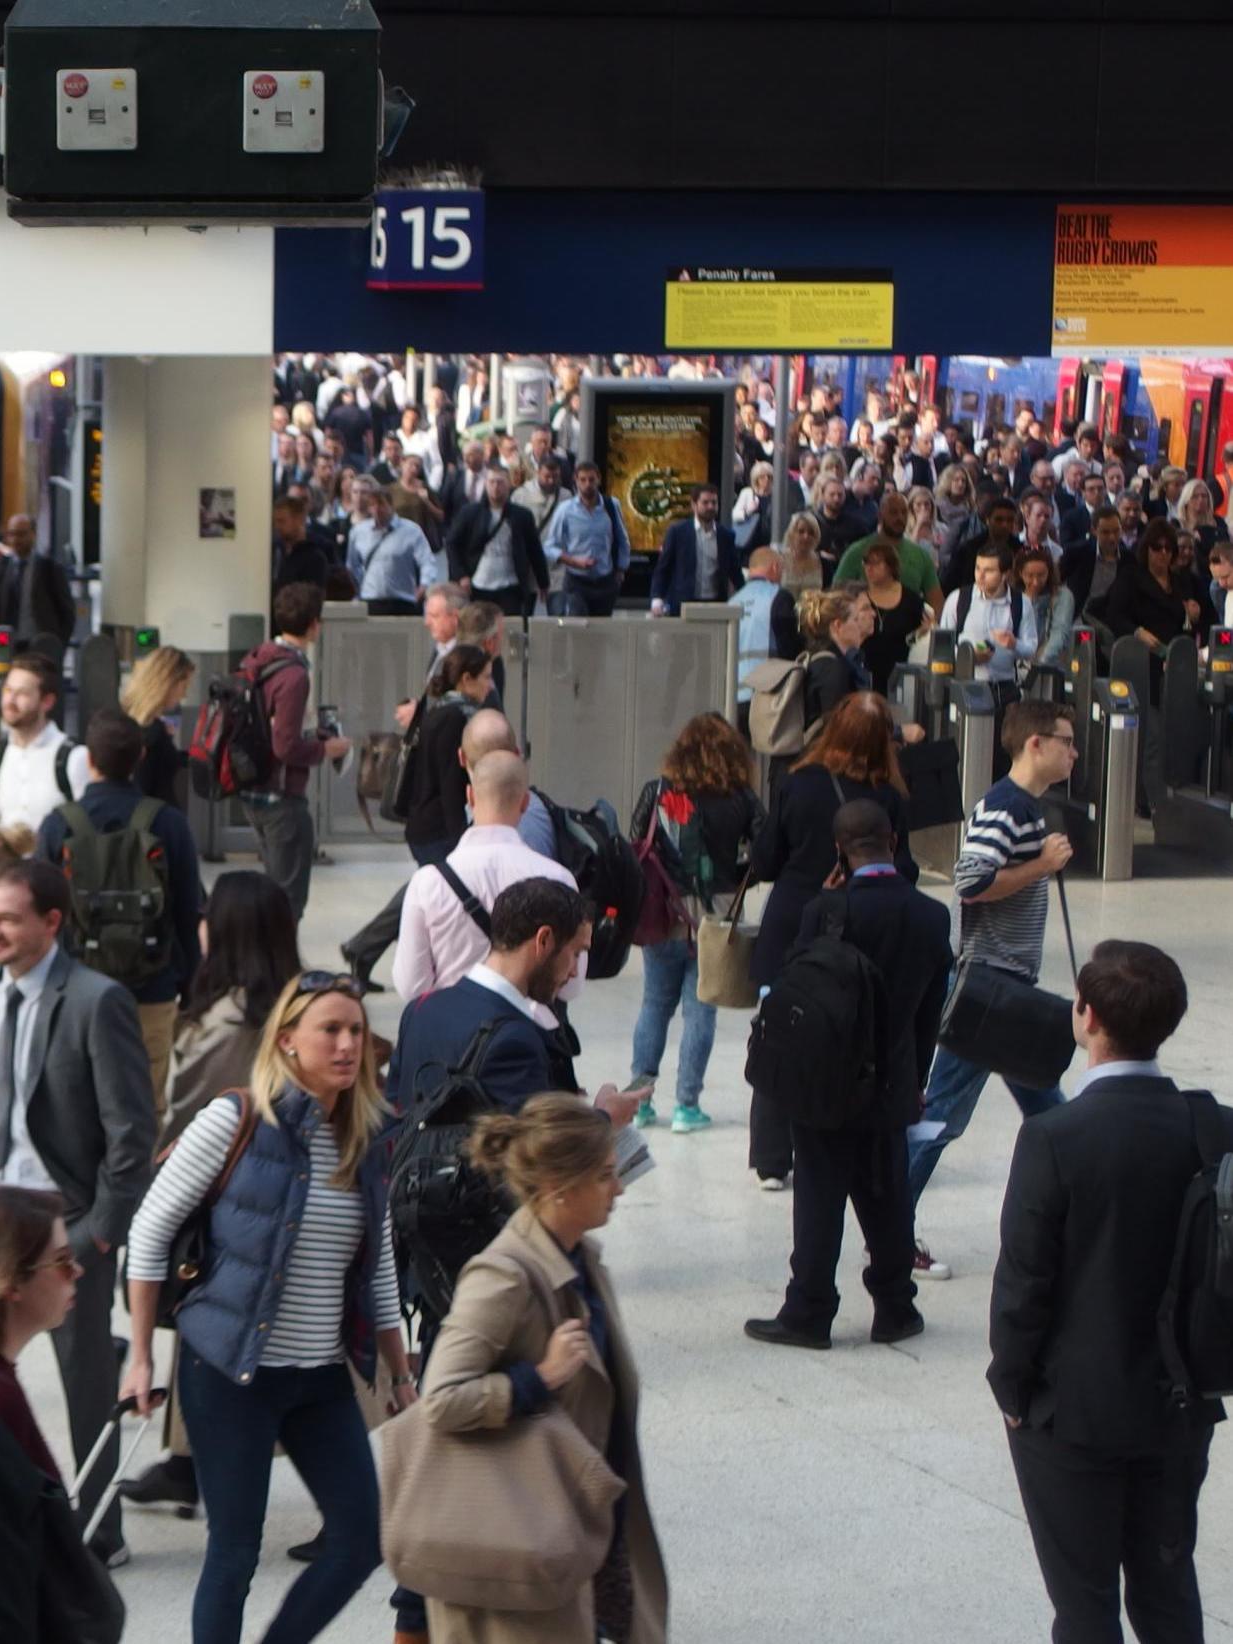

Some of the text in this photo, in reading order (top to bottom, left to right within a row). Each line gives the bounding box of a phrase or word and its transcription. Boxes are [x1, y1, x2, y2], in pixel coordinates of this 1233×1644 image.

[400, 206, 472, 271] 15
[1057, 214, 1112, 239] BEAT THE
[1057, 240, 1157, 265] RUGBY CROWDS
[697, 268, 775, 282] Penalty Fares
[767, 287, 793, 297] before
